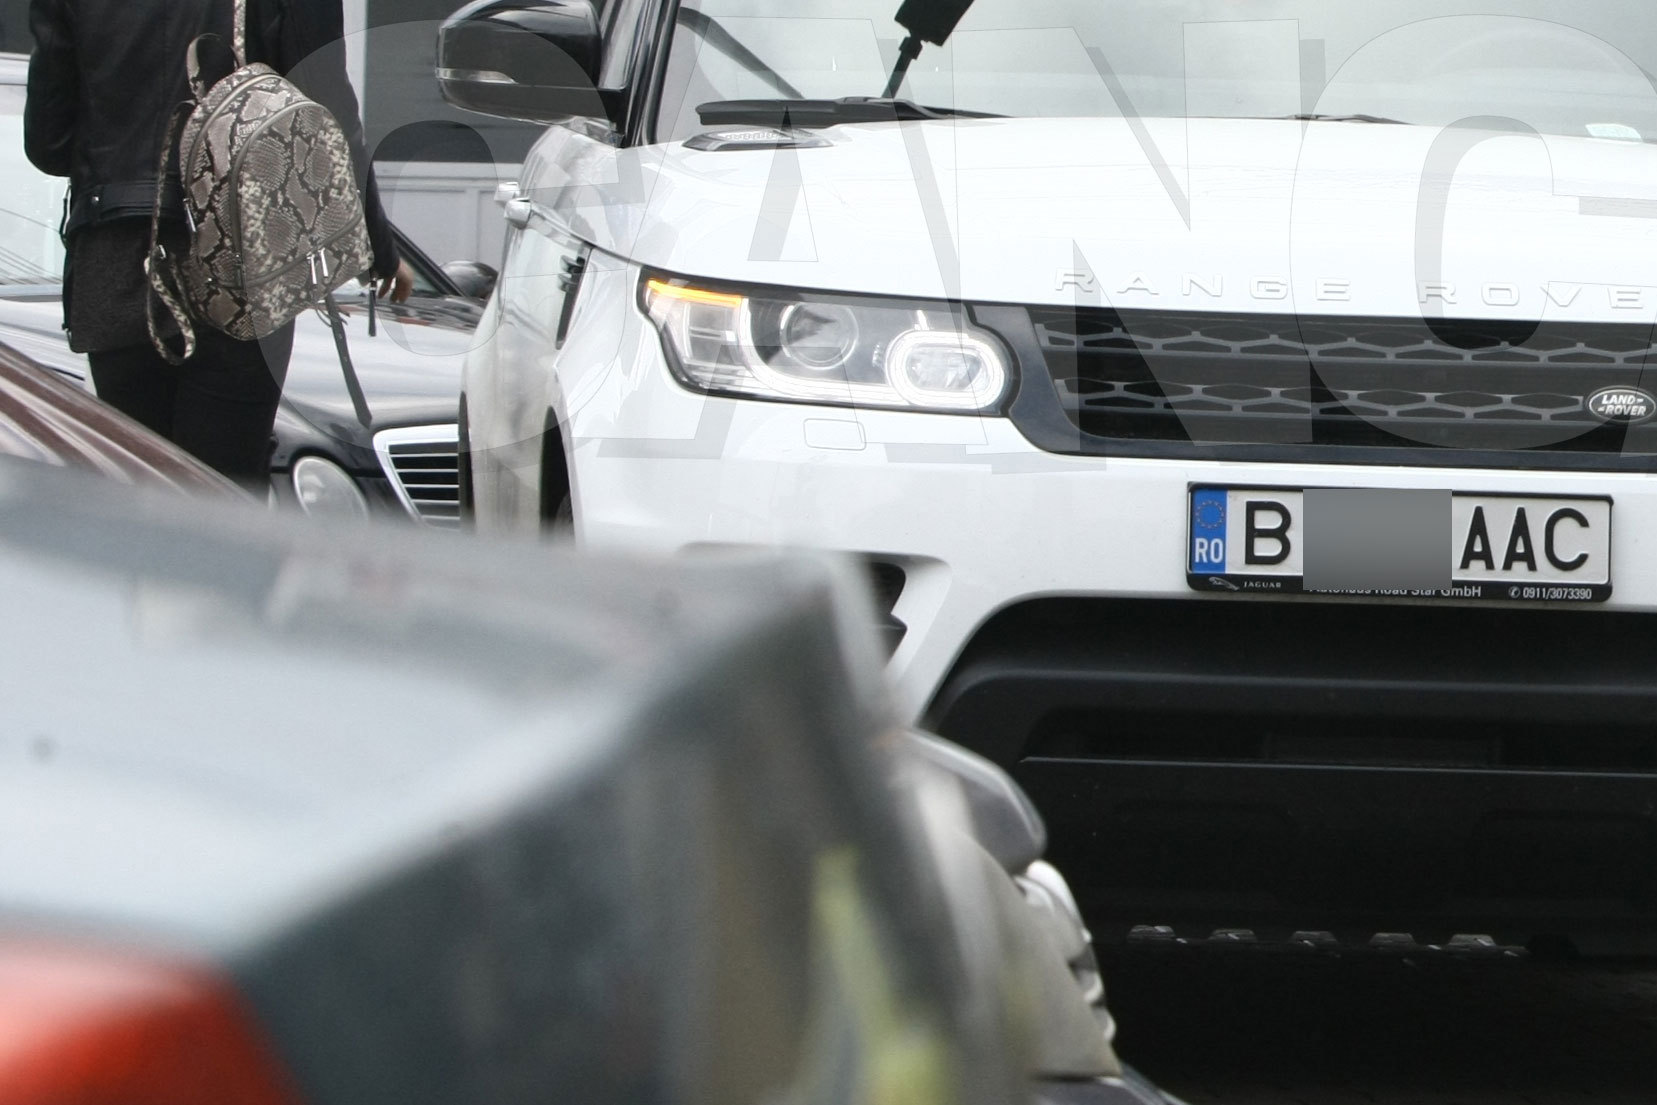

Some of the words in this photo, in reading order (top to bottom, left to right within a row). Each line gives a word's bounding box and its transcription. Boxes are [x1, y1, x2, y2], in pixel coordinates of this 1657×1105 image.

[1054, 266, 1354, 302] RANGE
[1194, 537, 1224, 565] RO
[1243, 499, 1292, 567] B
[1459, 505, 1591, 573] AAC
[1243, 581, 1282, 589] JAGUAR
